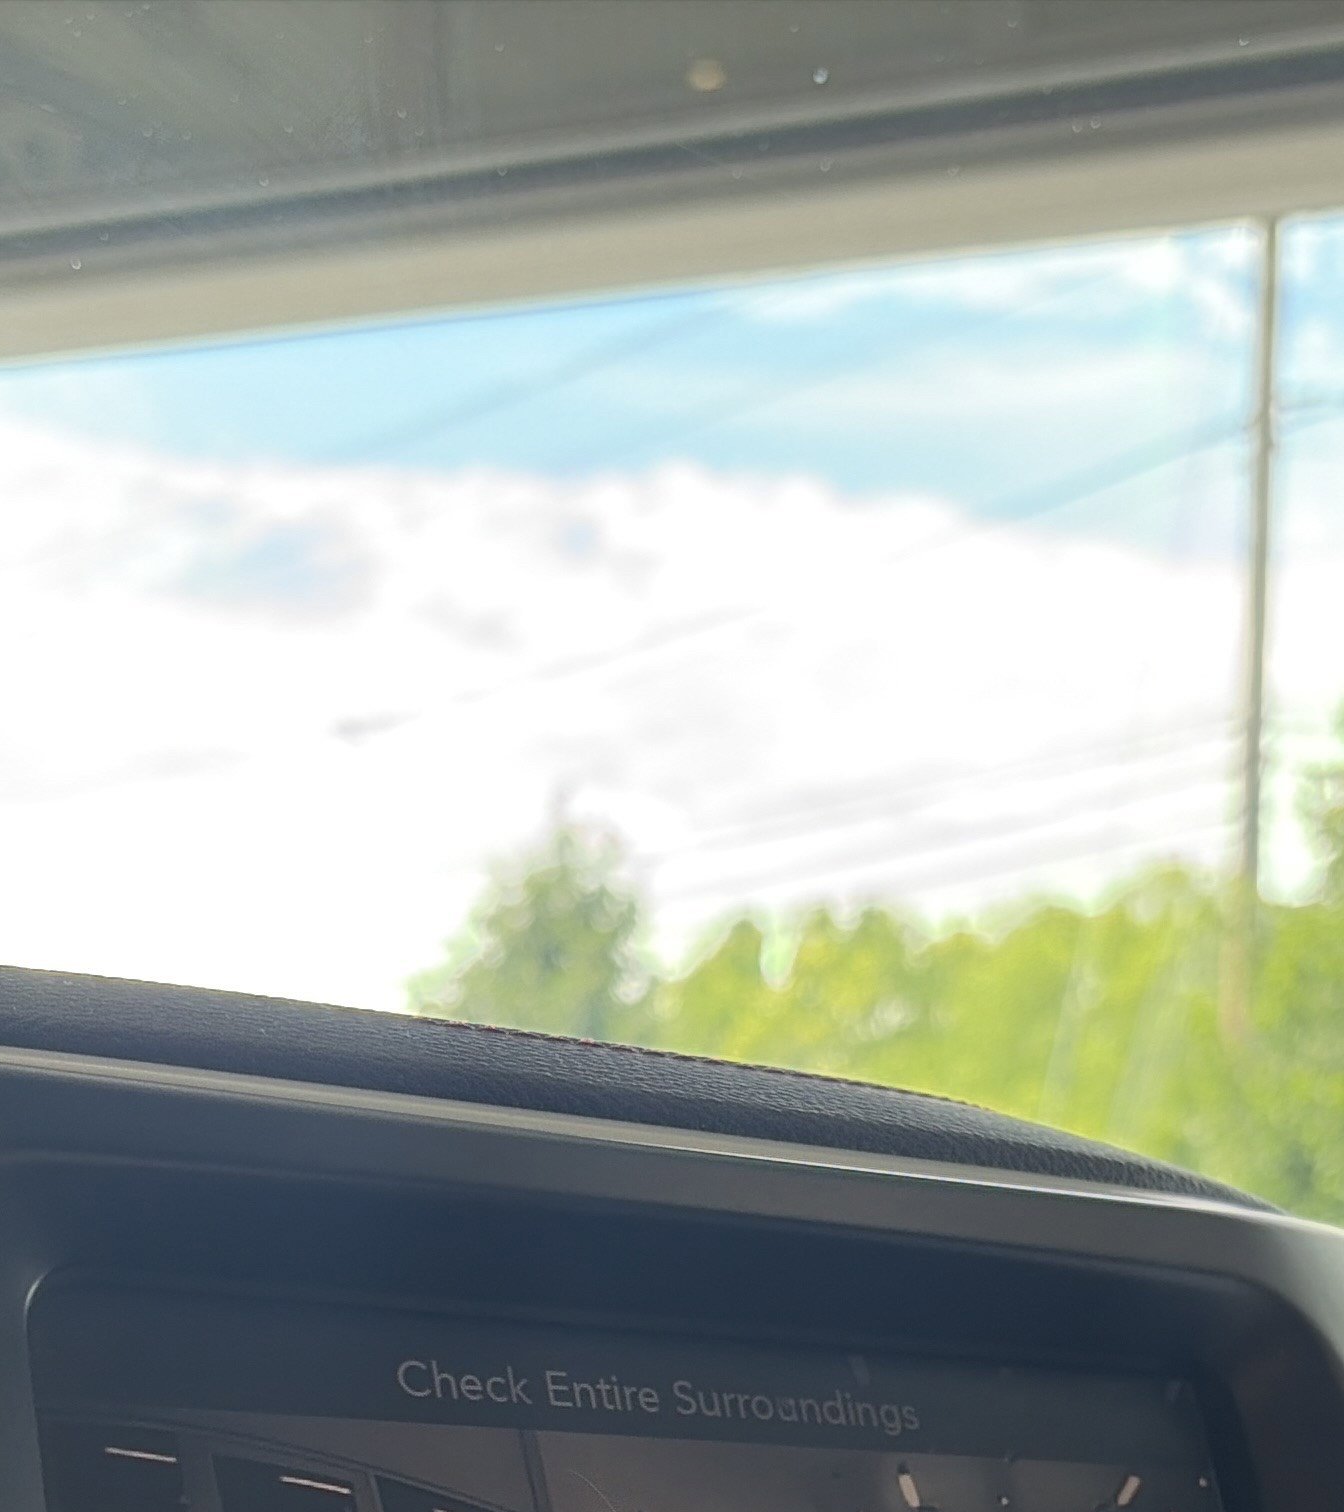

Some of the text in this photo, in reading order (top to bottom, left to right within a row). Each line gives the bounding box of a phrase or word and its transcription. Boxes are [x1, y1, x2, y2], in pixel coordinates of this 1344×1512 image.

[396, 1360, 920, 1436] Check Entire Surroundings
